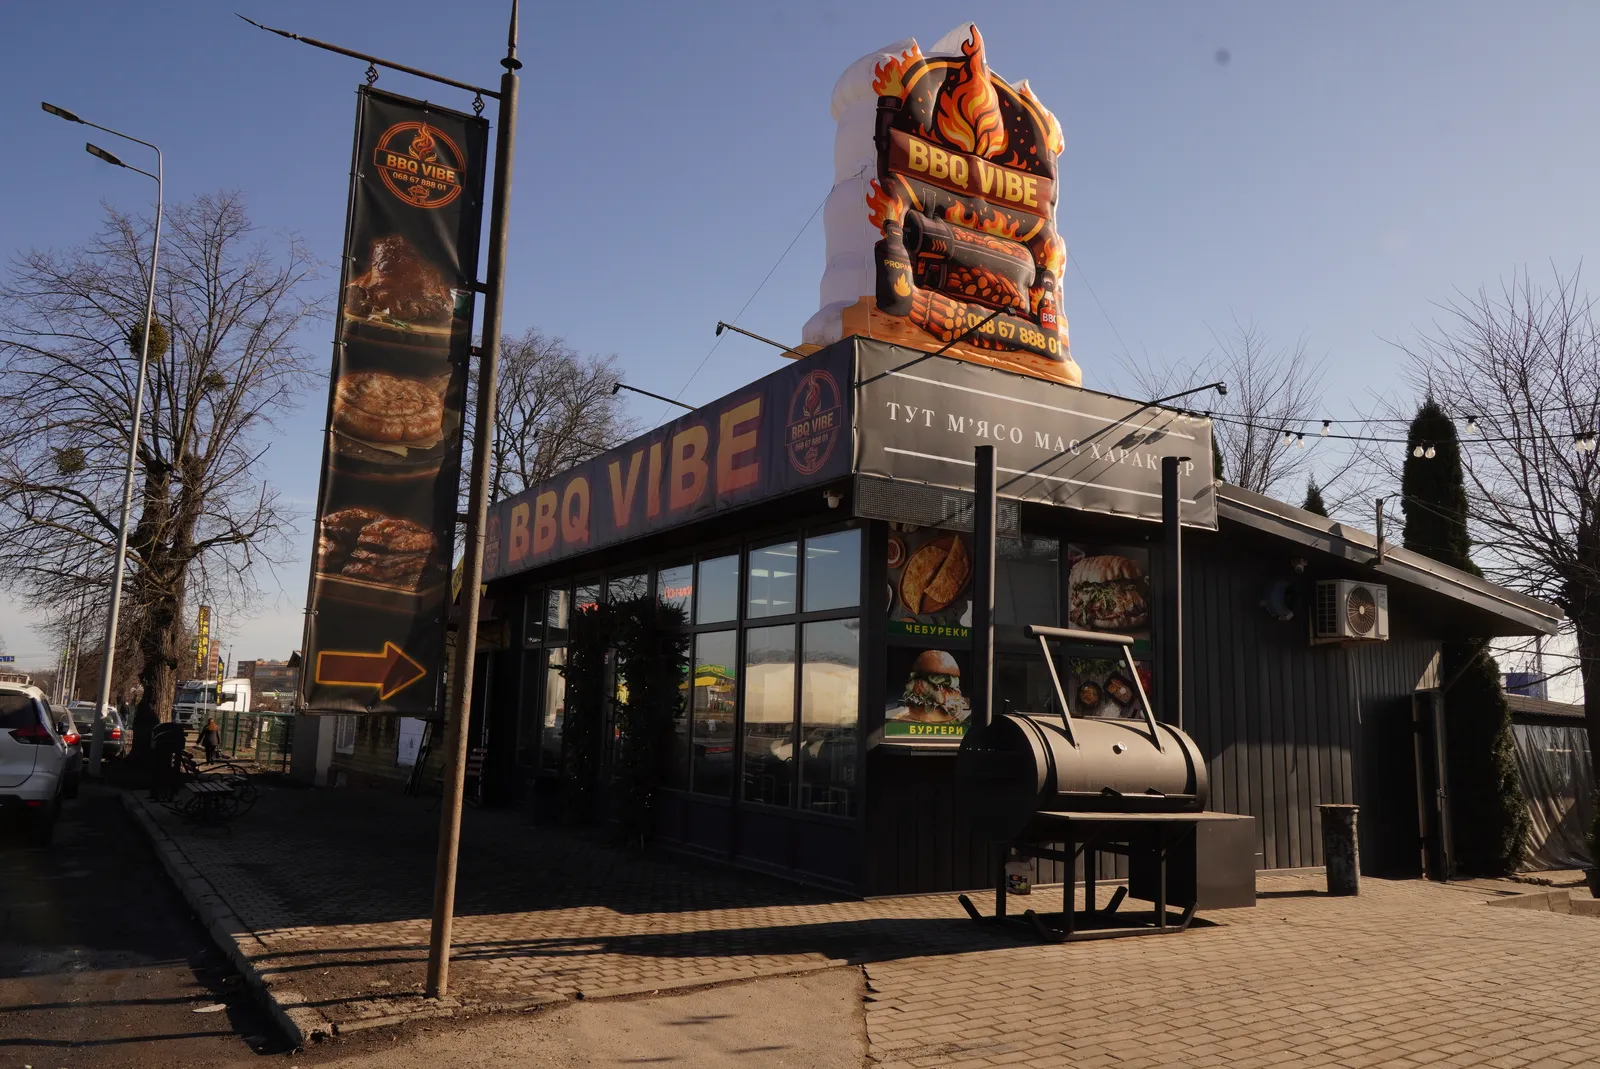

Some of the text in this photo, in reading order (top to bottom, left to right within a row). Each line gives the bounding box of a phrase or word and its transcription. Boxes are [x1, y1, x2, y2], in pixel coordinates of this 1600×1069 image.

[387, 154, 455, 183] BBQ VIBE
[392, 171, 447, 191] 068 67 888 01
[908, 138, 1038, 208] BBQ VIBE
[998, 321, 1015, 339] 67
[1019, 327, 1046, 349] 888
[1048, 337, 1062, 356] 01
[792, 412, 834, 440] BBQ VIBE
[886, 401, 935, 428] ТУТ
[1034, 430, 1081, 456] МАЄ
[1090, 442, 1195, 477] ХАРАКР
[507, 396, 761, 562] BBQ VIBE
[905, 624, 968, 637] ЧЕБУРЕКИ
[909, 725, 963, 735] БУРГЕРИ
